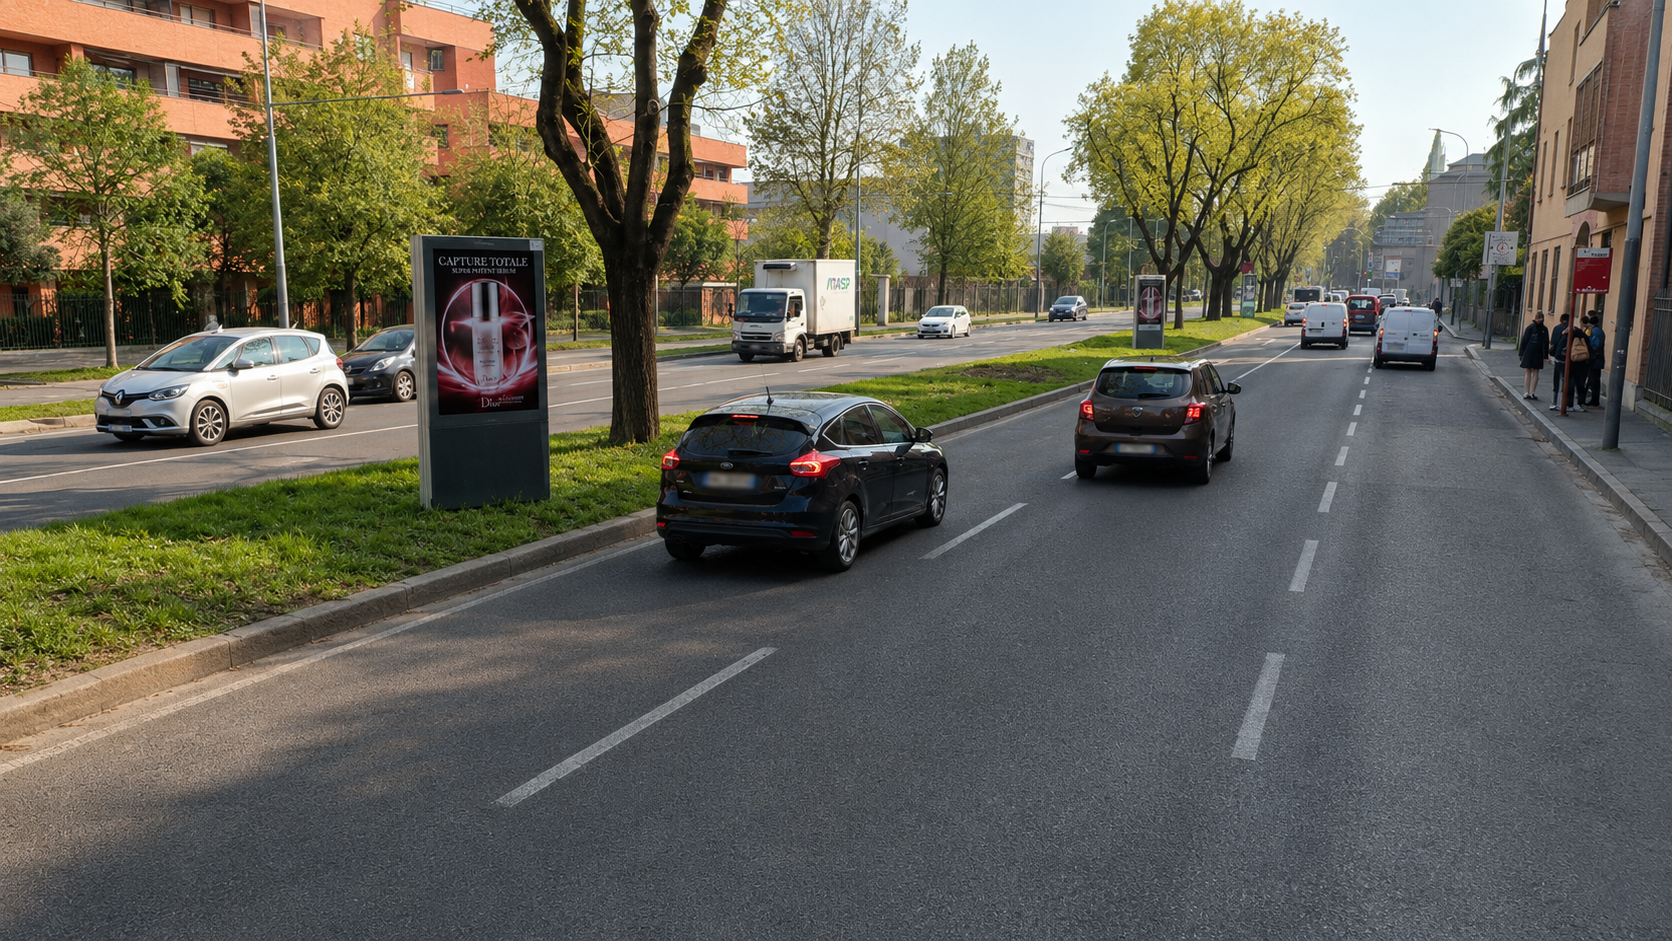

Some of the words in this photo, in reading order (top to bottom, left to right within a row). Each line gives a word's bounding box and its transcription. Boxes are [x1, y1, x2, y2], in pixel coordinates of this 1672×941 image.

[438, 256, 488, 266] CAPTURE
[489, 257, 528, 267] TOTALE
[481, 396, 501, 408] Dior
